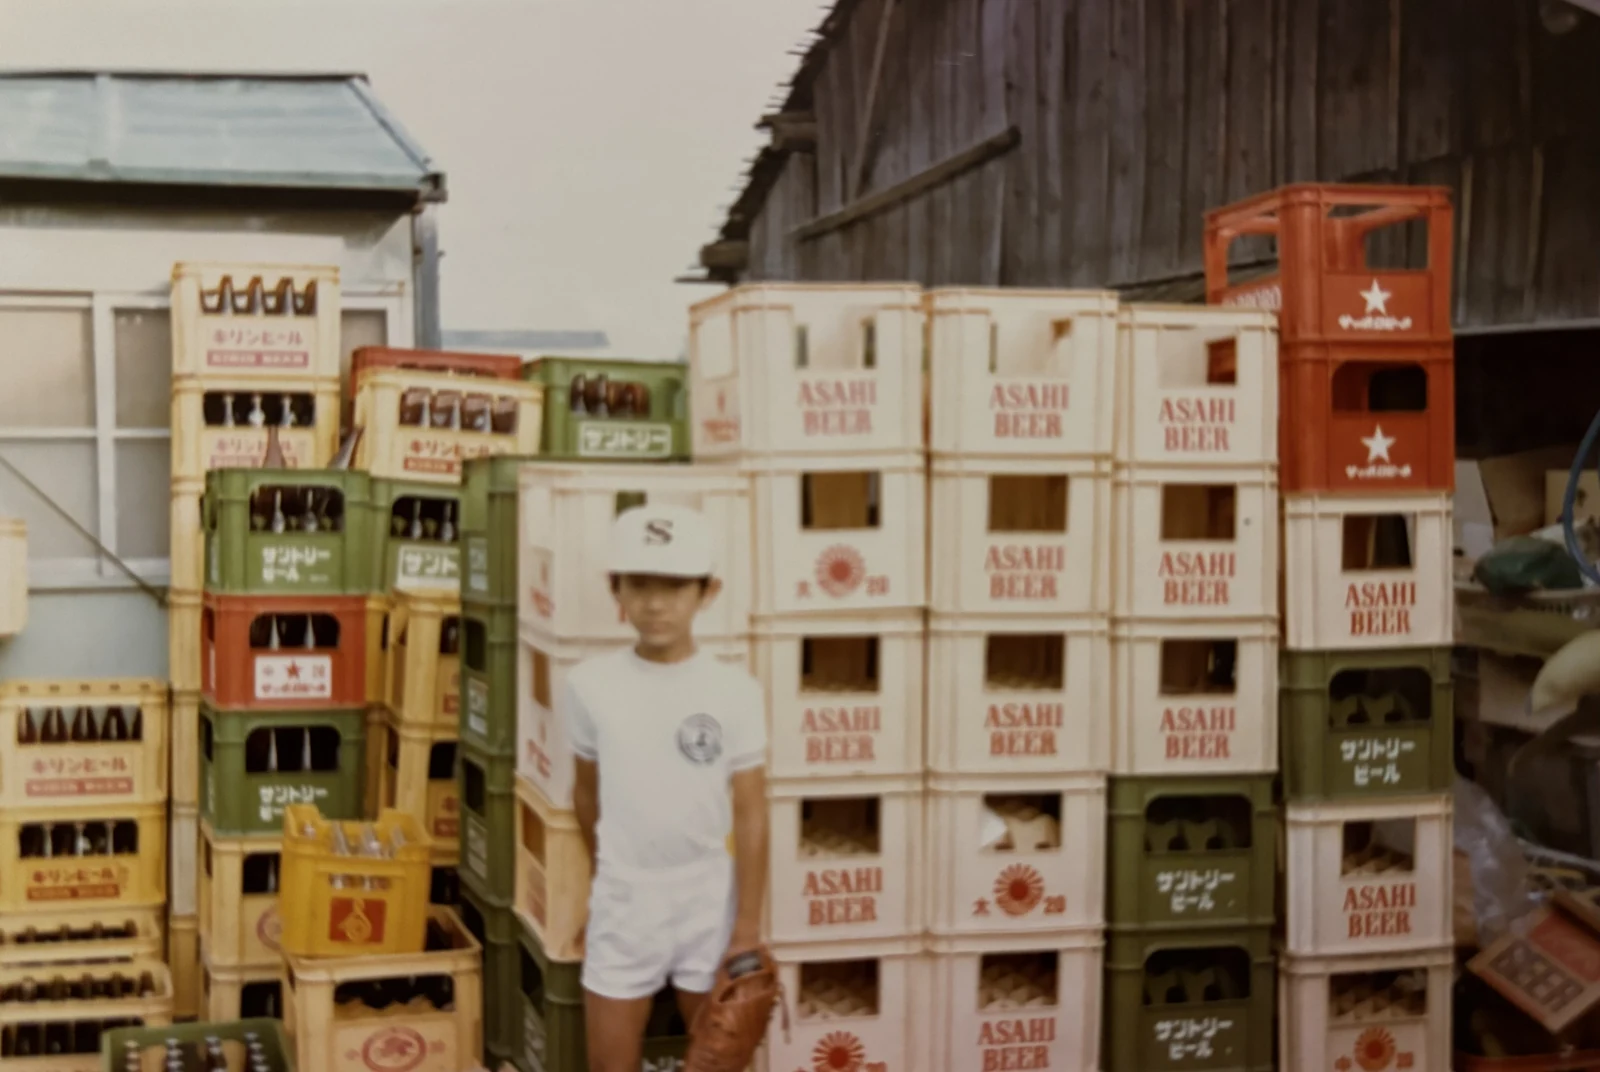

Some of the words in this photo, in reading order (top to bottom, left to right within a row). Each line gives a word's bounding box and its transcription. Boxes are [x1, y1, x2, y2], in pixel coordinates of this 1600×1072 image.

[798, 380, 877, 407] ASAHI
[990, 383, 1069, 410] ASAHI
[804, 408, 872, 437] BEER
[1158, 397, 1236, 424] ASAHI
[994, 411, 1063, 439] BEER
[1164, 425, 1230, 451] BEER
[644, 519, 674, 546] S
[262, 546, 331, 566] サントリー
[985, 546, 1065, 573] ASAHI
[1158, 551, 1236, 577] ASAHI
[989, 573, 1058, 600] BEER
[1164, 578, 1230, 605] BEER
[1345, 582, 1416, 609] ASAHI
[1351, 609, 1410, 637] BEER
[801, 706, 880, 733] ASAHI
[984, 703, 1063, 728] ASAHI
[1159, 707, 1236, 733] ASAHI
[806, 734, 876, 764] BEER
[989, 729, 1057, 757] BEER
[1165, 733, 1231, 760] BEER
[1341, 738, 1415, 761] サントリー
[1354, 763, 1400, 787] ビール
[802, 866, 883, 897] ASAHI
[1157, 869, 1235, 892] サントリー
[1170, 892, 1215, 913] ビール
[1343, 882, 1417, 912] ASAHI
[808, 896, 877, 927] BEER
[1348, 910, 1412, 938] BEER
[977, 1017, 1056, 1046] ASAHI
[1154, 1017, 1233, 1041] サントリー
[982, 1045, 1050, 1072] BEER
[1168, 1038, 1213, 1060] ビール
